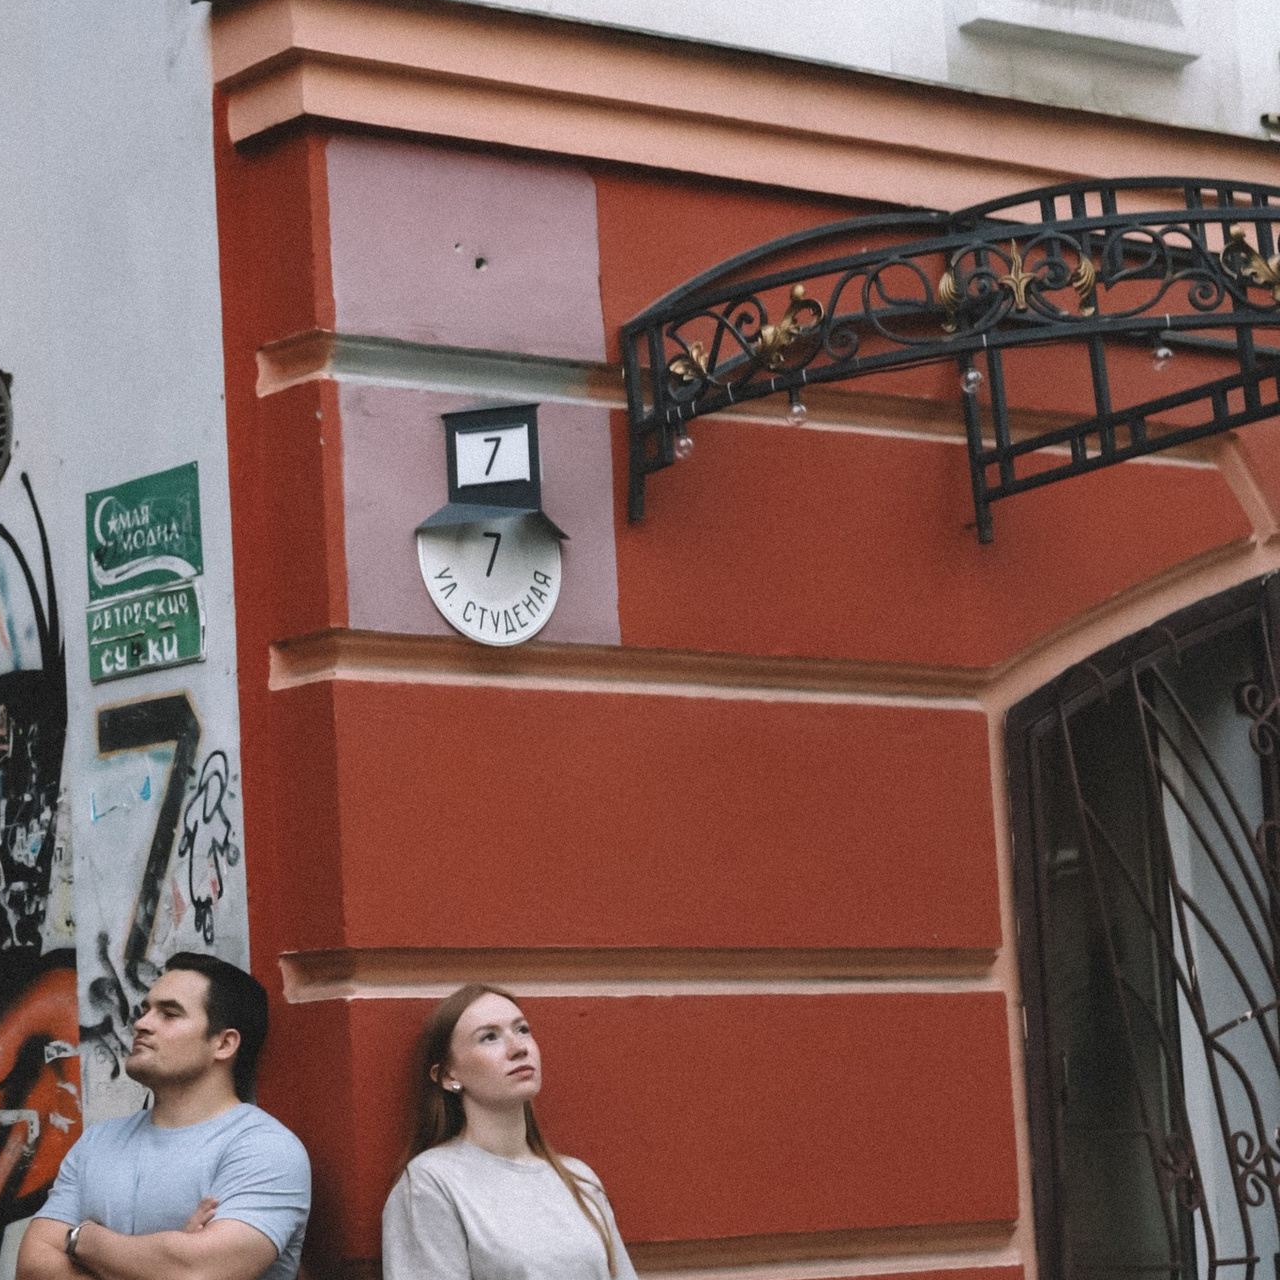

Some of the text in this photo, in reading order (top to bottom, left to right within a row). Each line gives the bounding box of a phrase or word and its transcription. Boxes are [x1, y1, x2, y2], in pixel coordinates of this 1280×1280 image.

[484, 437, 501, 476] 7
[483, 532, 501, 577] 7
[463, 570, 552, 635] СТУДЕНАЯ
[101, 633, 178, 673] СУКИ
